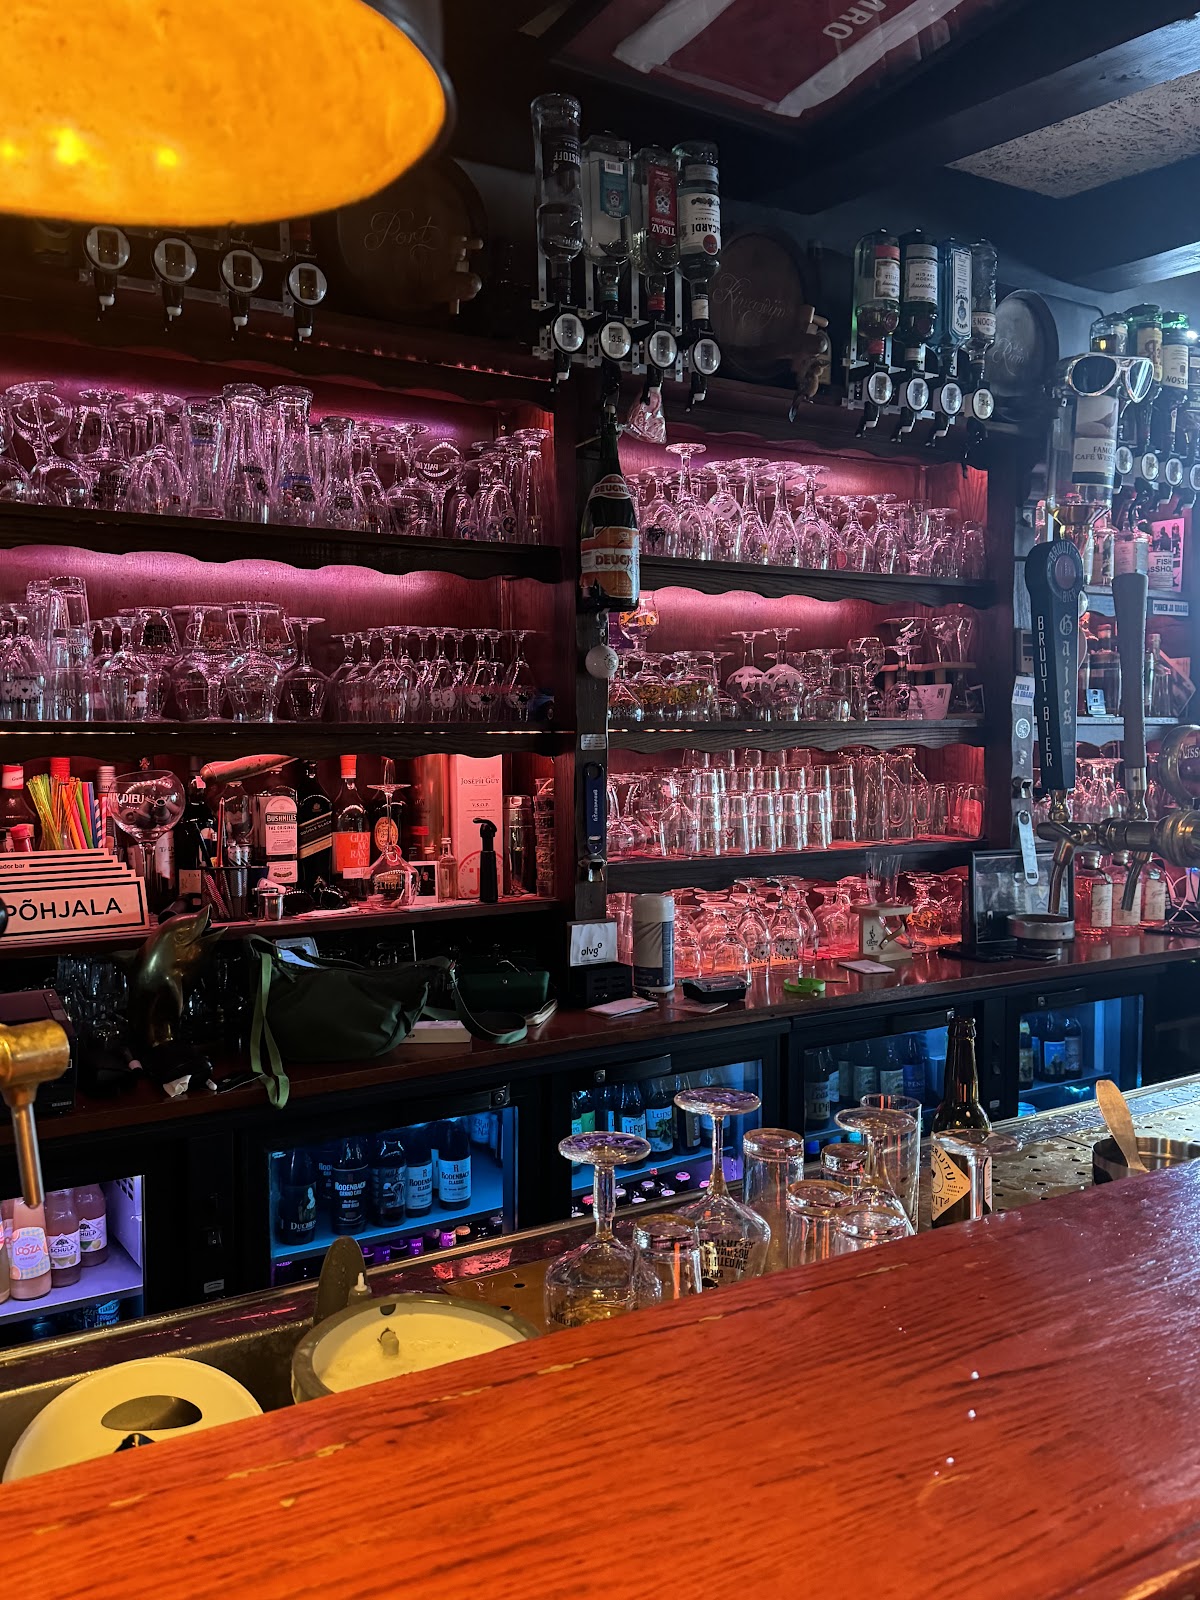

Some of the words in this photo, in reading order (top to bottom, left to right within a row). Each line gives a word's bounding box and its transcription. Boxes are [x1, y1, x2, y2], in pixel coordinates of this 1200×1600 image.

[364, 208, 440, 251] Port
[651, 223, 676, 236] TISCAZ
[1037, 615, 1047, 693] BRUUT
[1043, 706, 1052, 767] BIER
[122, 793, 145, 804] DIEU
[266, 814, 297, 822] BUSHMILLS
[6, 898, 123, 921] PÕHJALA
[80, 1230, 97, 1238] HULP
[50, 1245, 75, 1254] SCHULP
